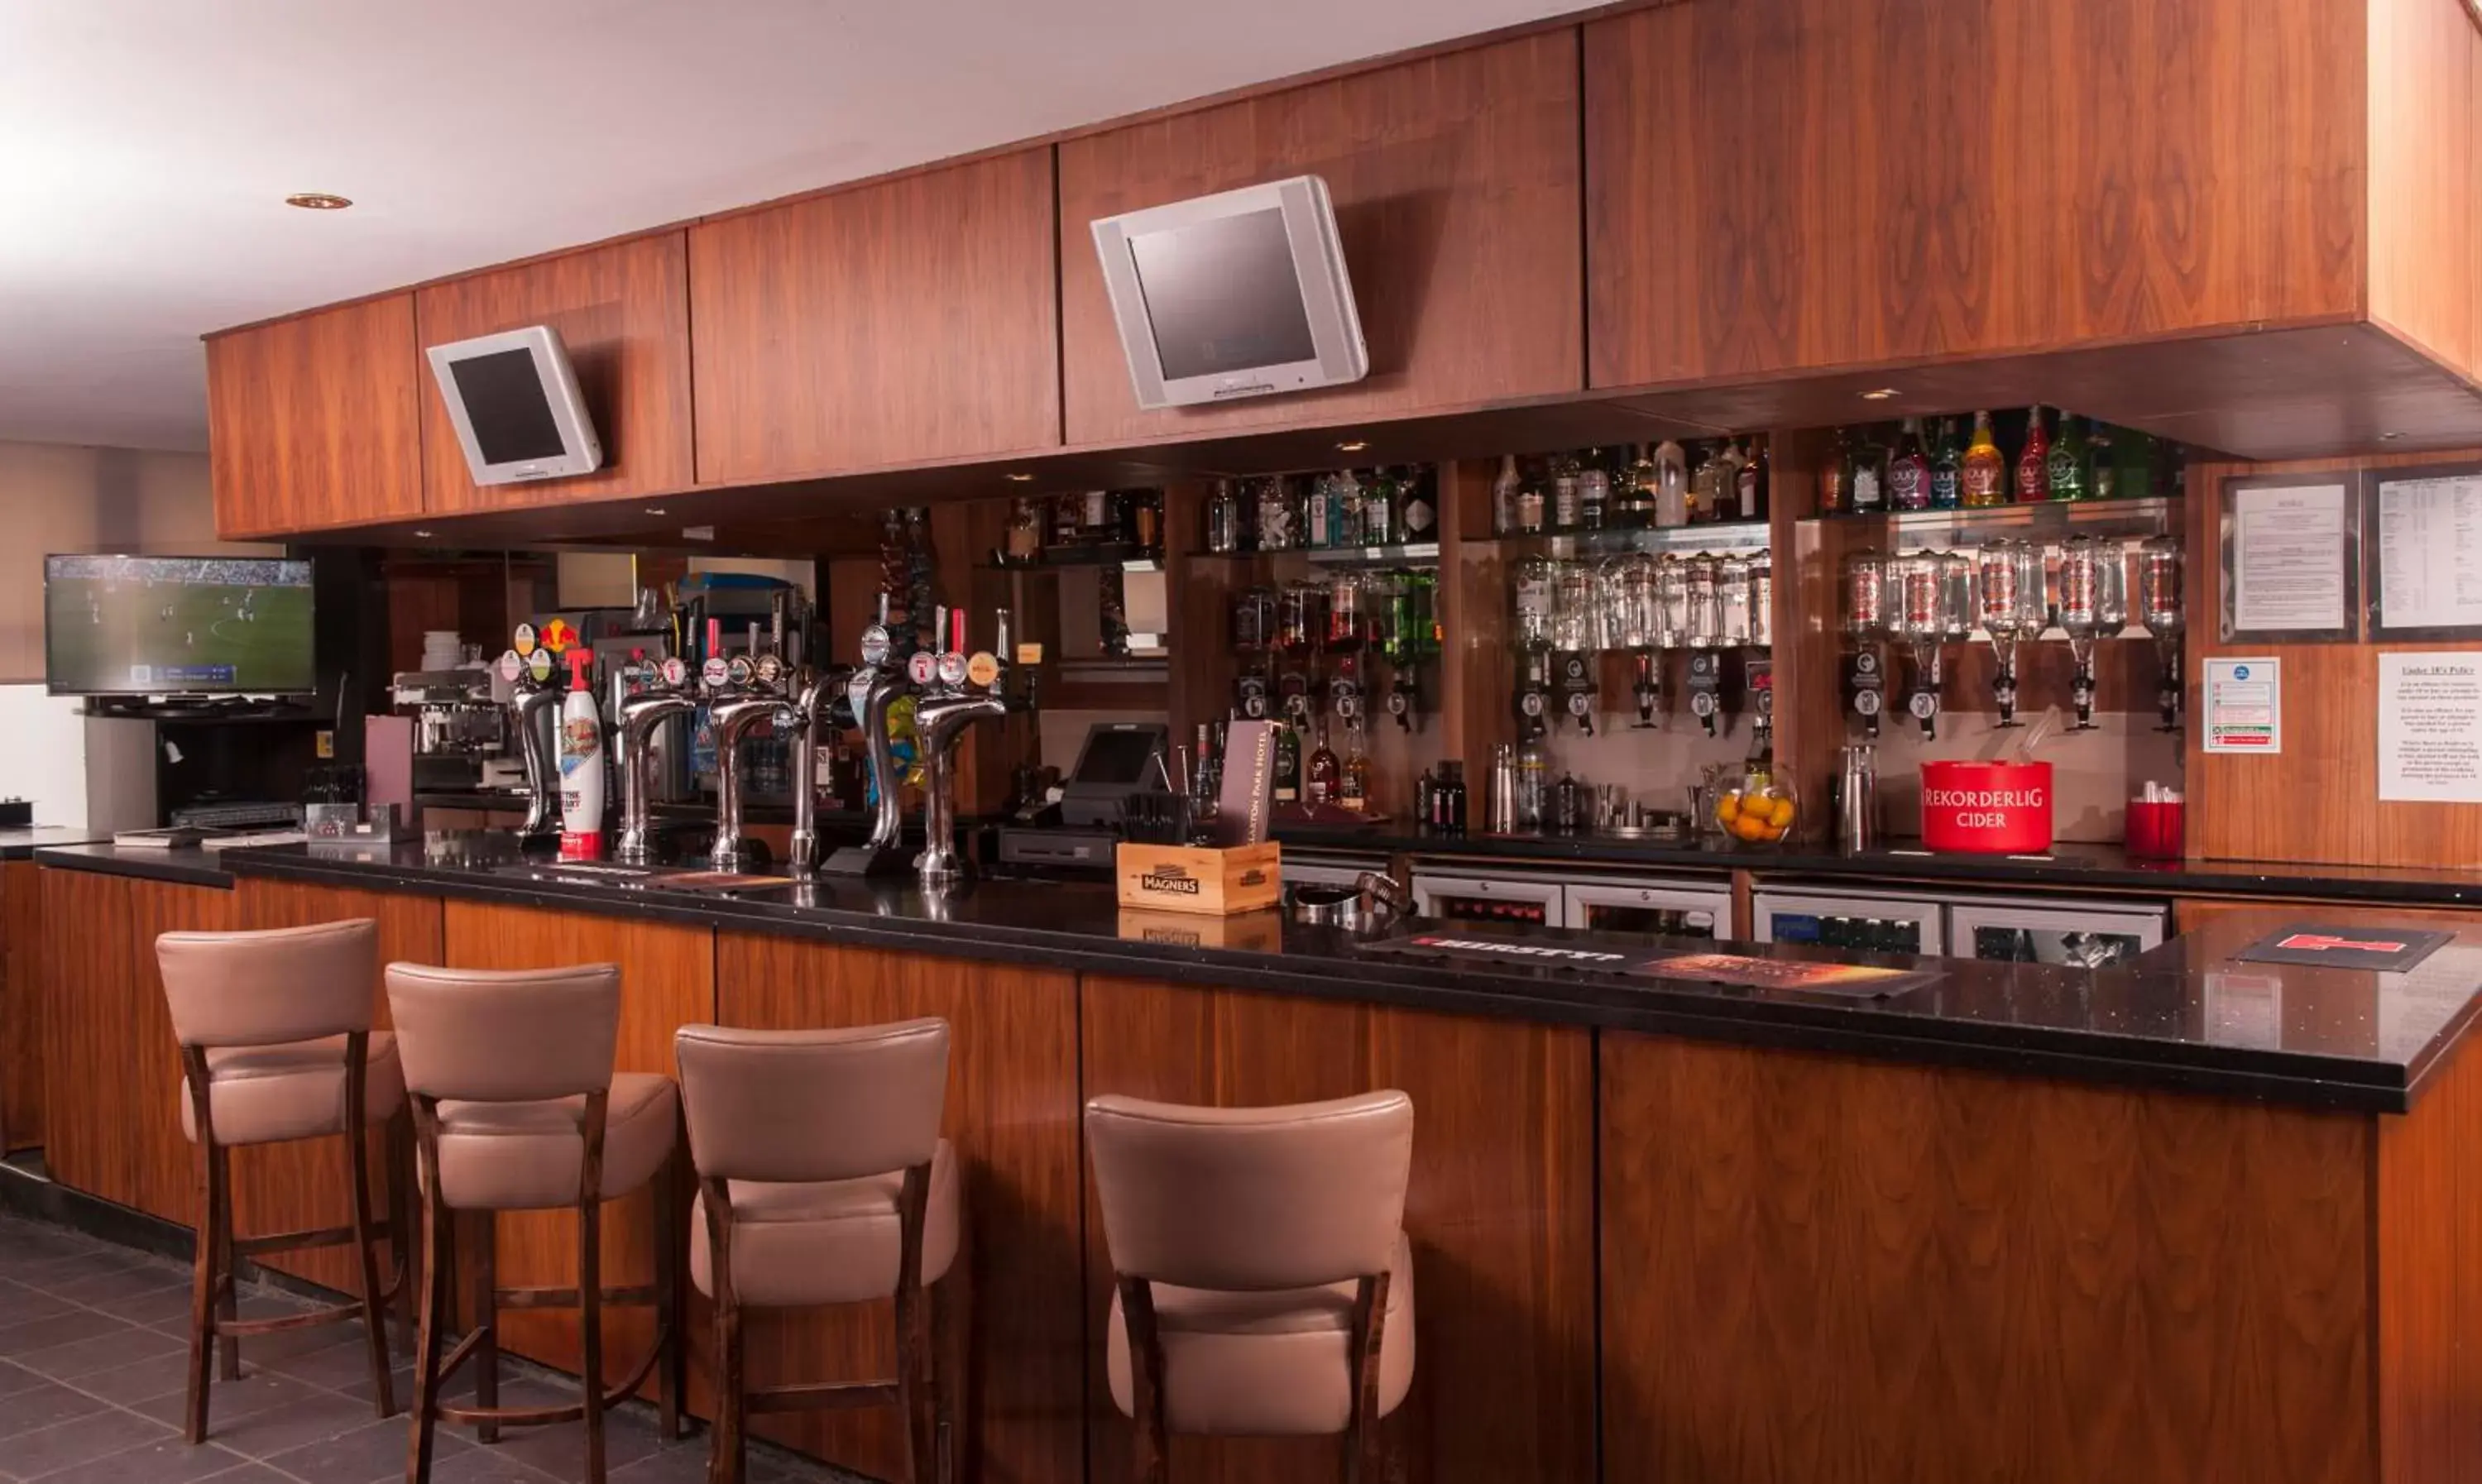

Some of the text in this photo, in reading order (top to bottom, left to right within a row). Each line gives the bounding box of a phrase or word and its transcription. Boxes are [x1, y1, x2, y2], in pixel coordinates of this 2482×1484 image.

[1255, 731, 1269, 766] HOTEL
[1924, 787, 2043, 808] REKORDERLIG
[1956, 811, 2006, 828] CIDER
[1144, 876, 1196, 893] MAGNERS
